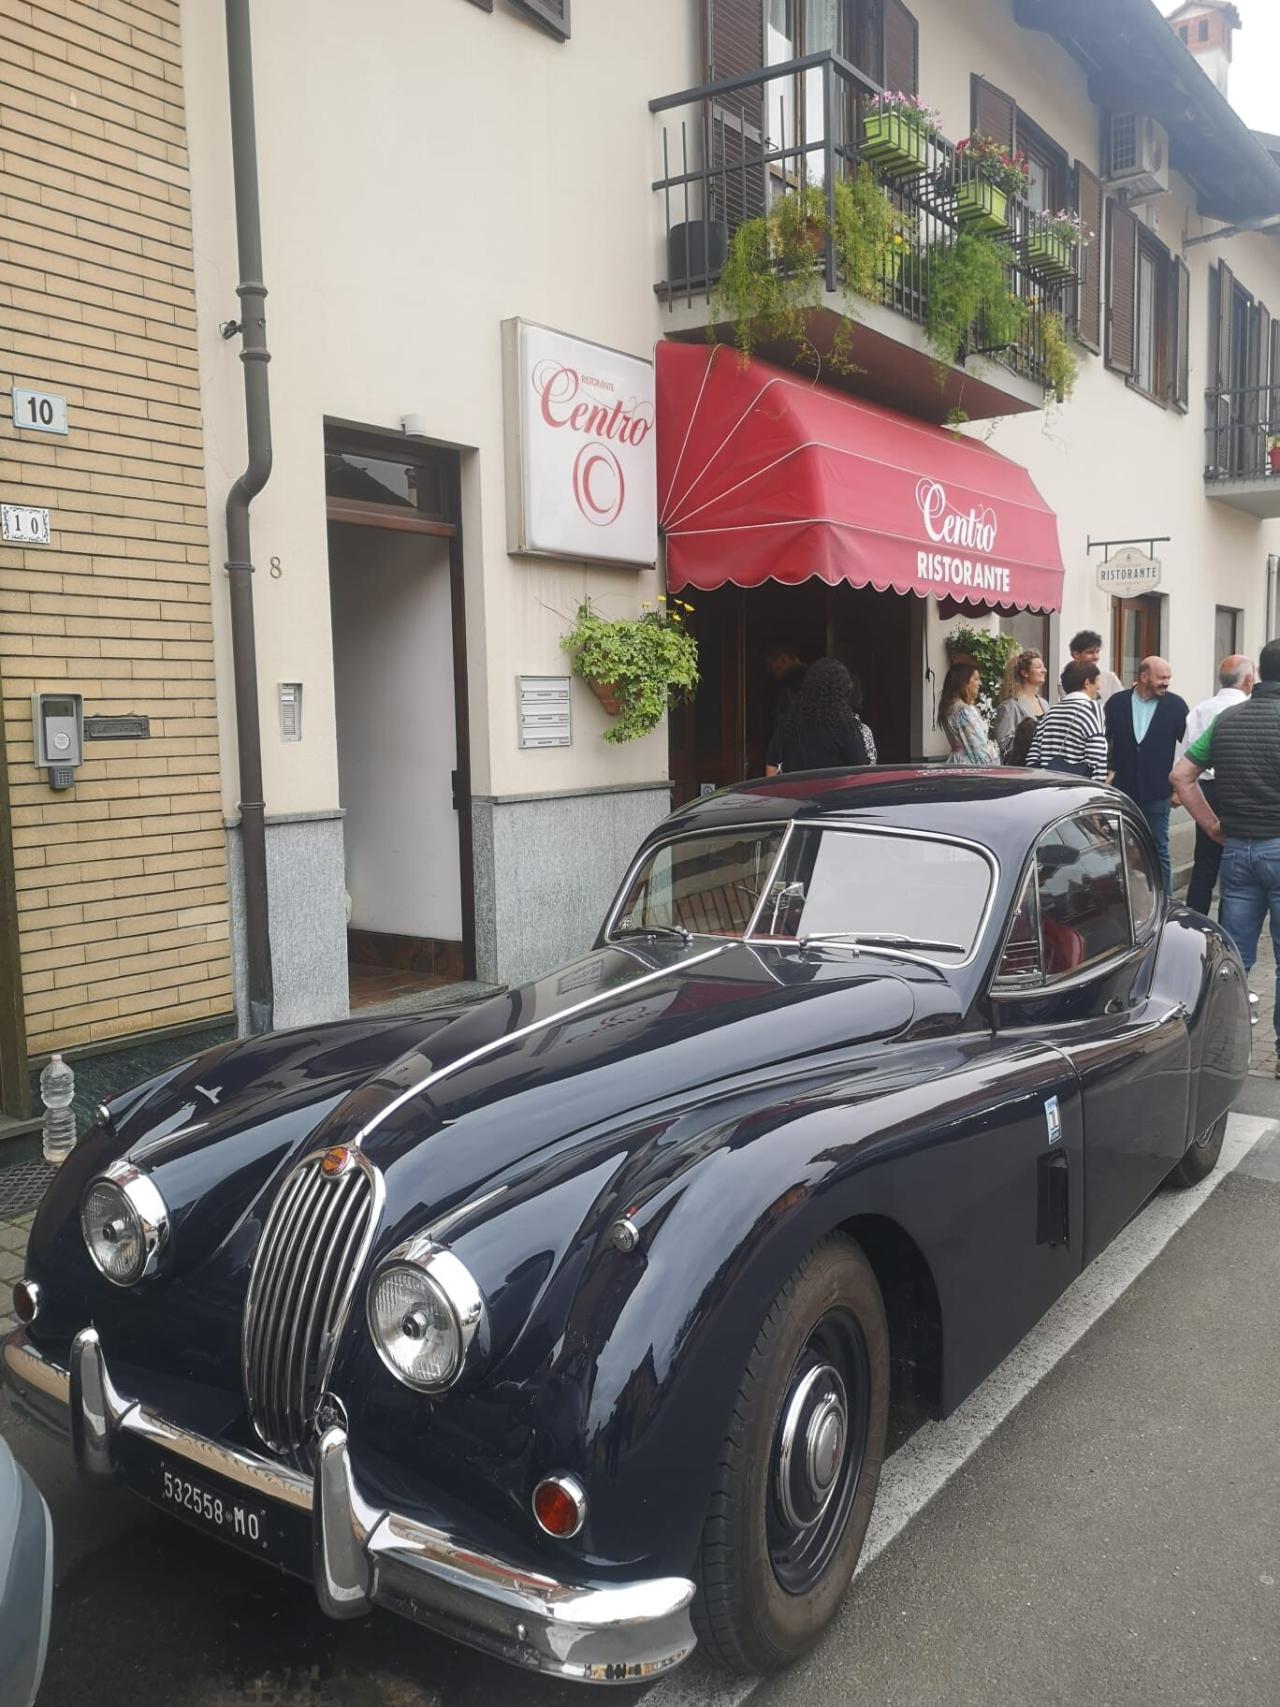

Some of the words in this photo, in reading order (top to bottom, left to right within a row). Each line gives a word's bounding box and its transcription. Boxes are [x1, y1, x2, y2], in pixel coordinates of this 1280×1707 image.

[27, 397, 53, 425] 10
[532, 359, 655, 446] Centro
[915, 478, 997, 552] Centro
[270, 556, 282, 579] 8
[917, 551, 1010, 592] RISTORANTE
[1100, 567, 1157, 581] RISTORANTE
[164, 1471, 223, 1525] 532558
[233, 1506, 259, 1540] MO
